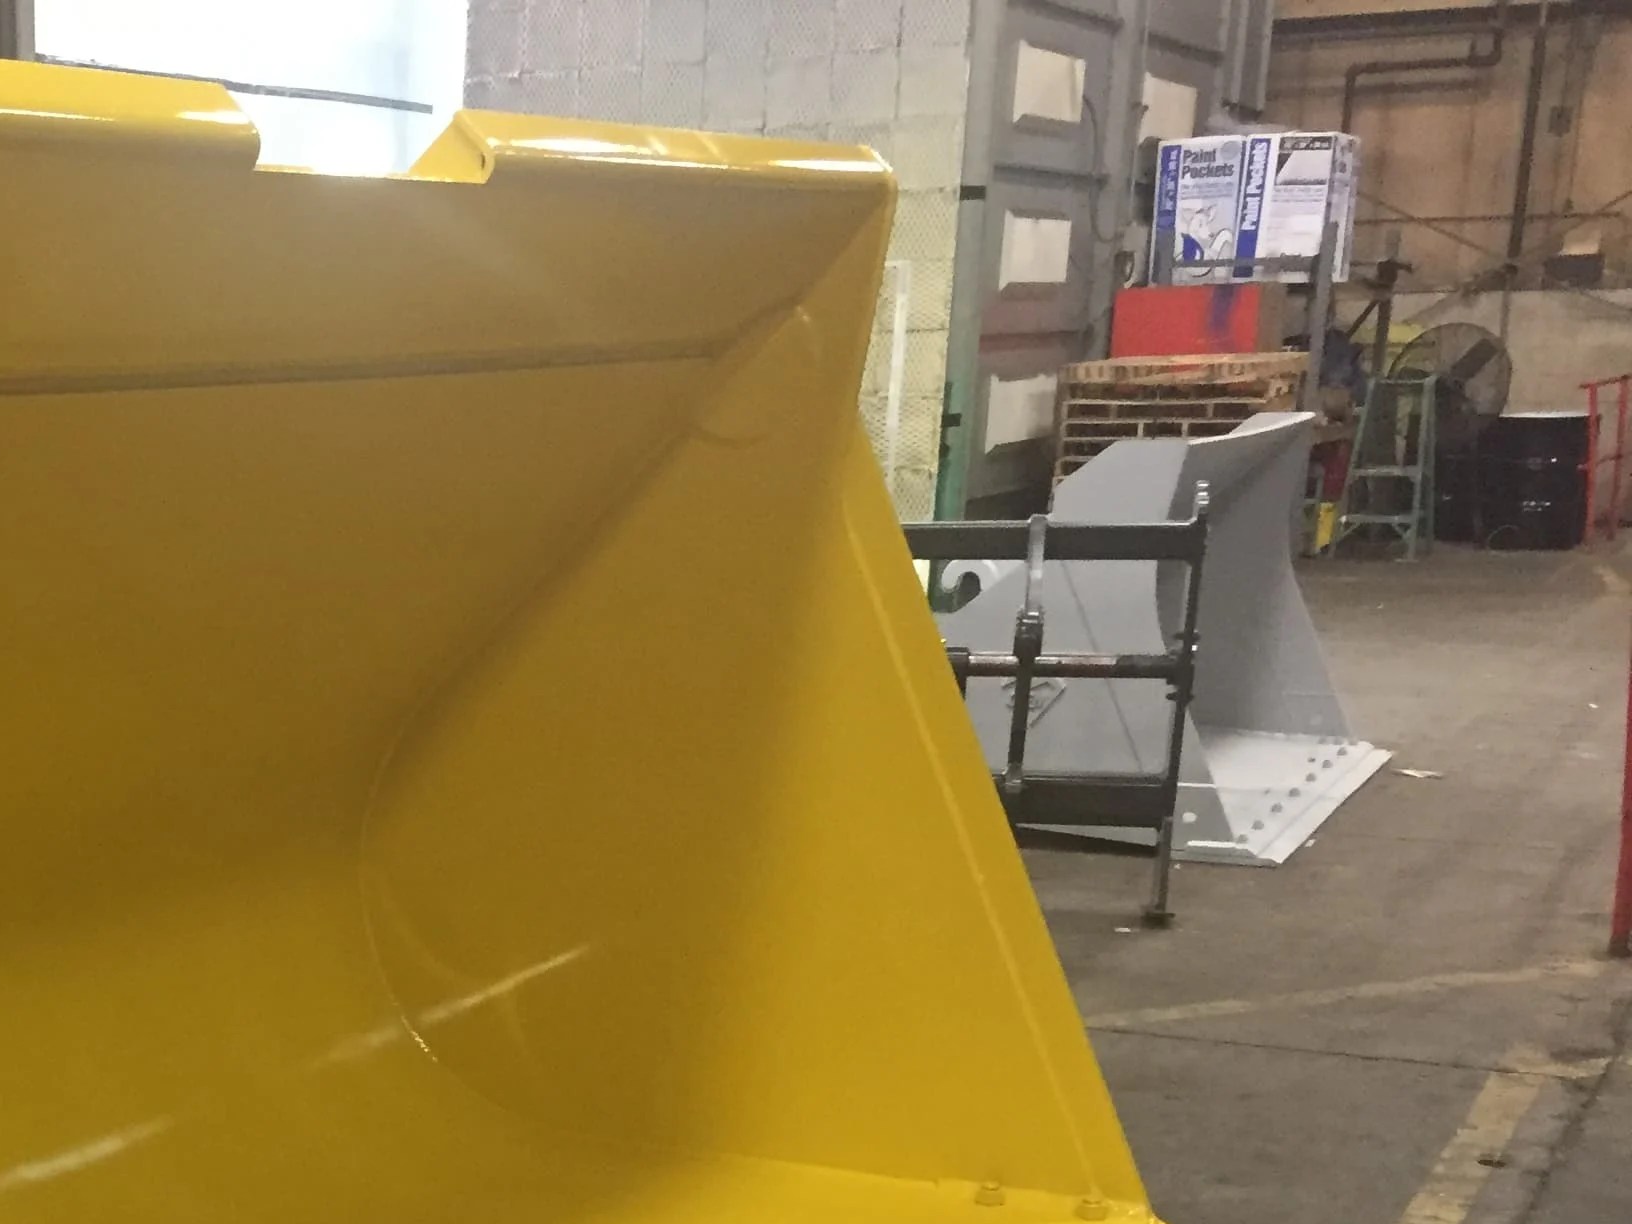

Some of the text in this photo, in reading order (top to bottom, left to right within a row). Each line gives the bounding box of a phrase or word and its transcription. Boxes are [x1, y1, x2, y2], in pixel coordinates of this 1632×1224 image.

[1183, 148, 1216, 164] Paint
[1181, 163, 1234, 179] Pockets
[1240, 196, 1260, 230] Paint
